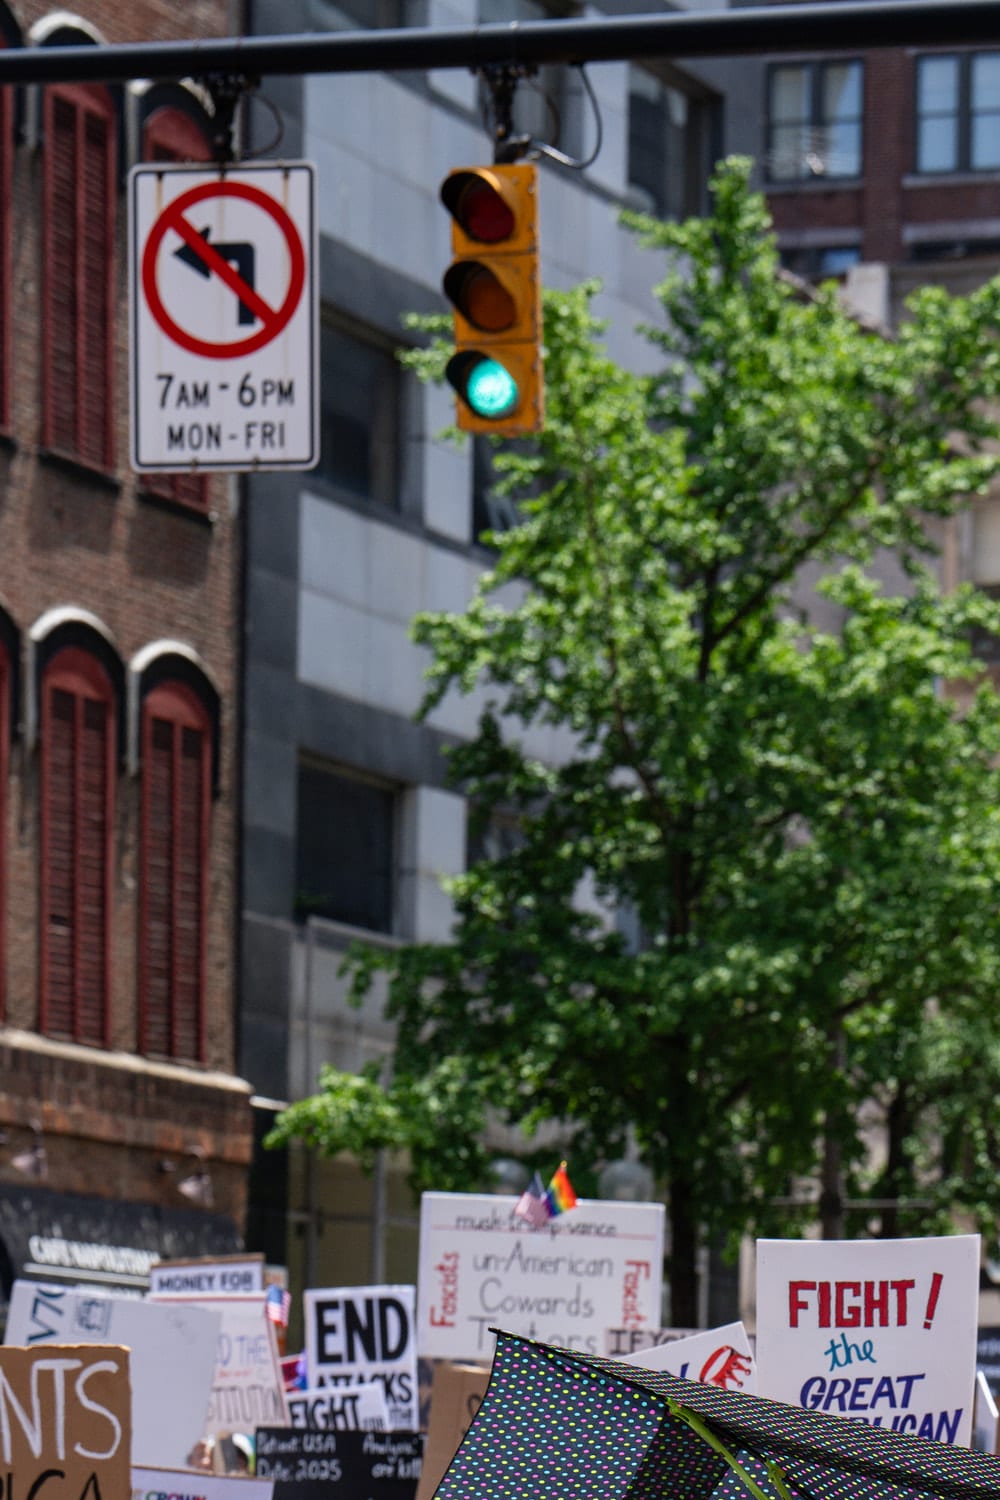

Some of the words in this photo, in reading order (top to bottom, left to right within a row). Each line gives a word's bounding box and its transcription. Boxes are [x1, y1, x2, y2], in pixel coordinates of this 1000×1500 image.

[473, 1240, 613, 1277] un-American
[158, 1272, 215, 1292] MONEY
[221, 1271, 253, 1288] FOR
[479, 1277, 595, 1319] Cowards
[788, 1272, 944, 1330] FIGHT!
[315, 1297, 409, 1364] END
[824, 1332, 878, 1372] the
[800, 1373, 926, 1411] GREAT
[289, 1394, 359, 1431] FIGHT
[303, 1433, 336, 1454] USA
[295, 1458, 343, 1482] 2025
